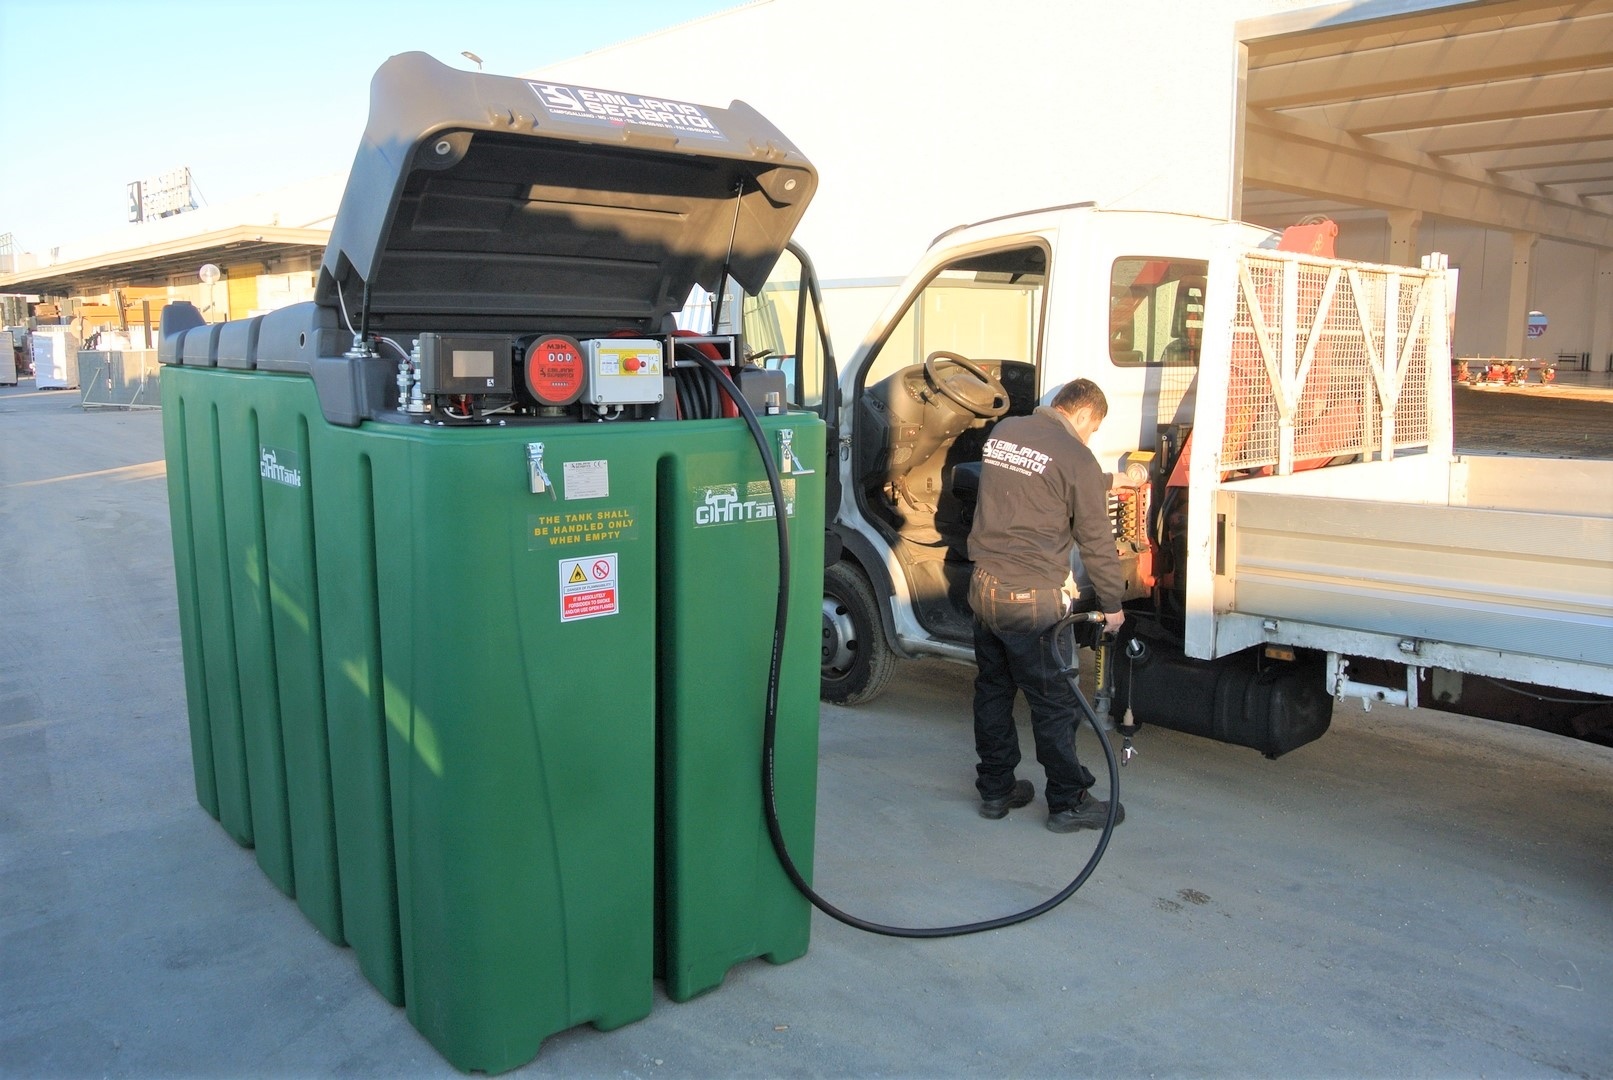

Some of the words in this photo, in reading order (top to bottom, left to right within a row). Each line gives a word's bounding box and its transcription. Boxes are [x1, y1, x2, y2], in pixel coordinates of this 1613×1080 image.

[577, 89, 701, 116] EMILIANA
[584, 101, 714, 129] SERBATOI
[996, 440, 1049, 465] EMILIANA
[991, 449, 1046, 475] SERBATOI
[539, 515, 560, 525] THE
[565, 512, 592, 523] TANK
[597, 509, 630, 520] SHALL
[534, 527, 549, 536] BE
[553, 522, 604, 534] HANDLED
[608, 519, 634, 529] ONLY
[549, 535, 581, 545] WHEN
[585, 531, 620, 542] EMPTY
[582, 592, 606, 600] ABSOLUTELY
[568, 601, 591, 609] FORBIDDEN
